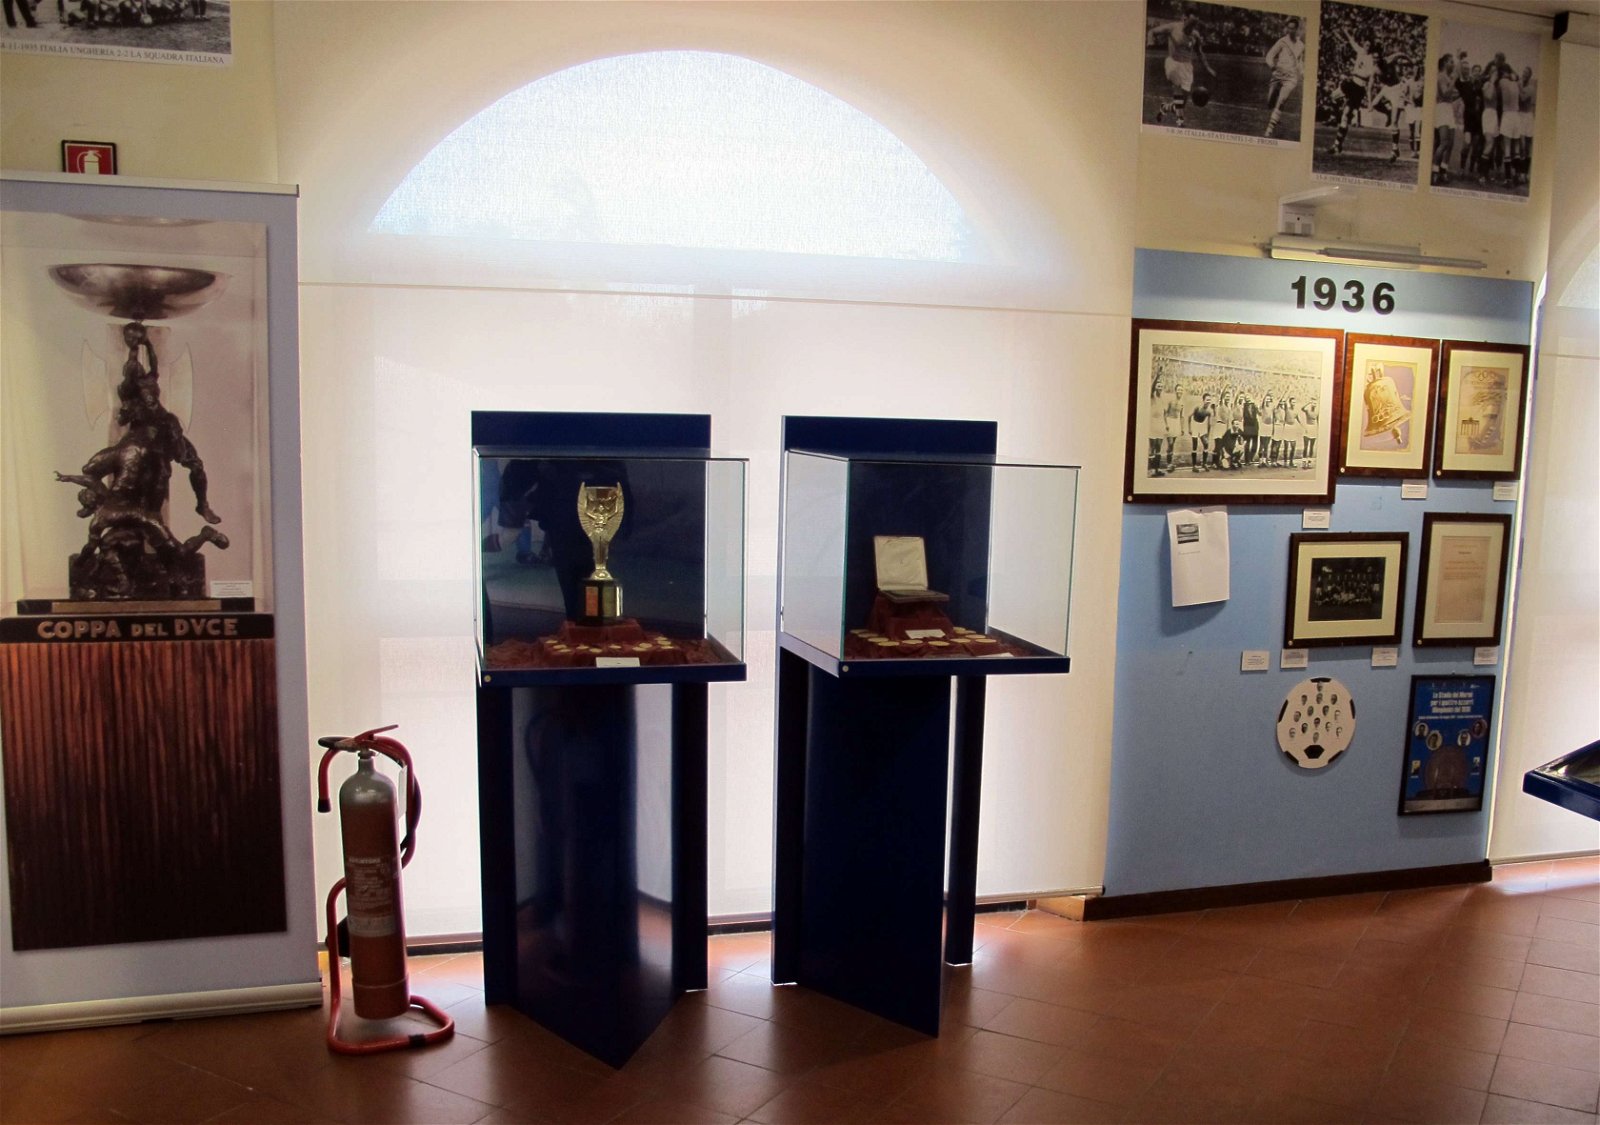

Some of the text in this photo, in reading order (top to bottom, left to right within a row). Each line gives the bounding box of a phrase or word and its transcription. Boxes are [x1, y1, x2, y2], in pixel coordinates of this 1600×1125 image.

[40, 43, 69, 54] ITALIA
[70, 46, 115, 57] UNGHERIA
[130, 51, 142, 59] LA
[143, 51, 184, 62] SQUADRA
[186, 54, 224, 64] ITALIANA
[1291, 275, 1396, 316] 1936
[37, 618, 239, 639] COPPA DEL DVCE
